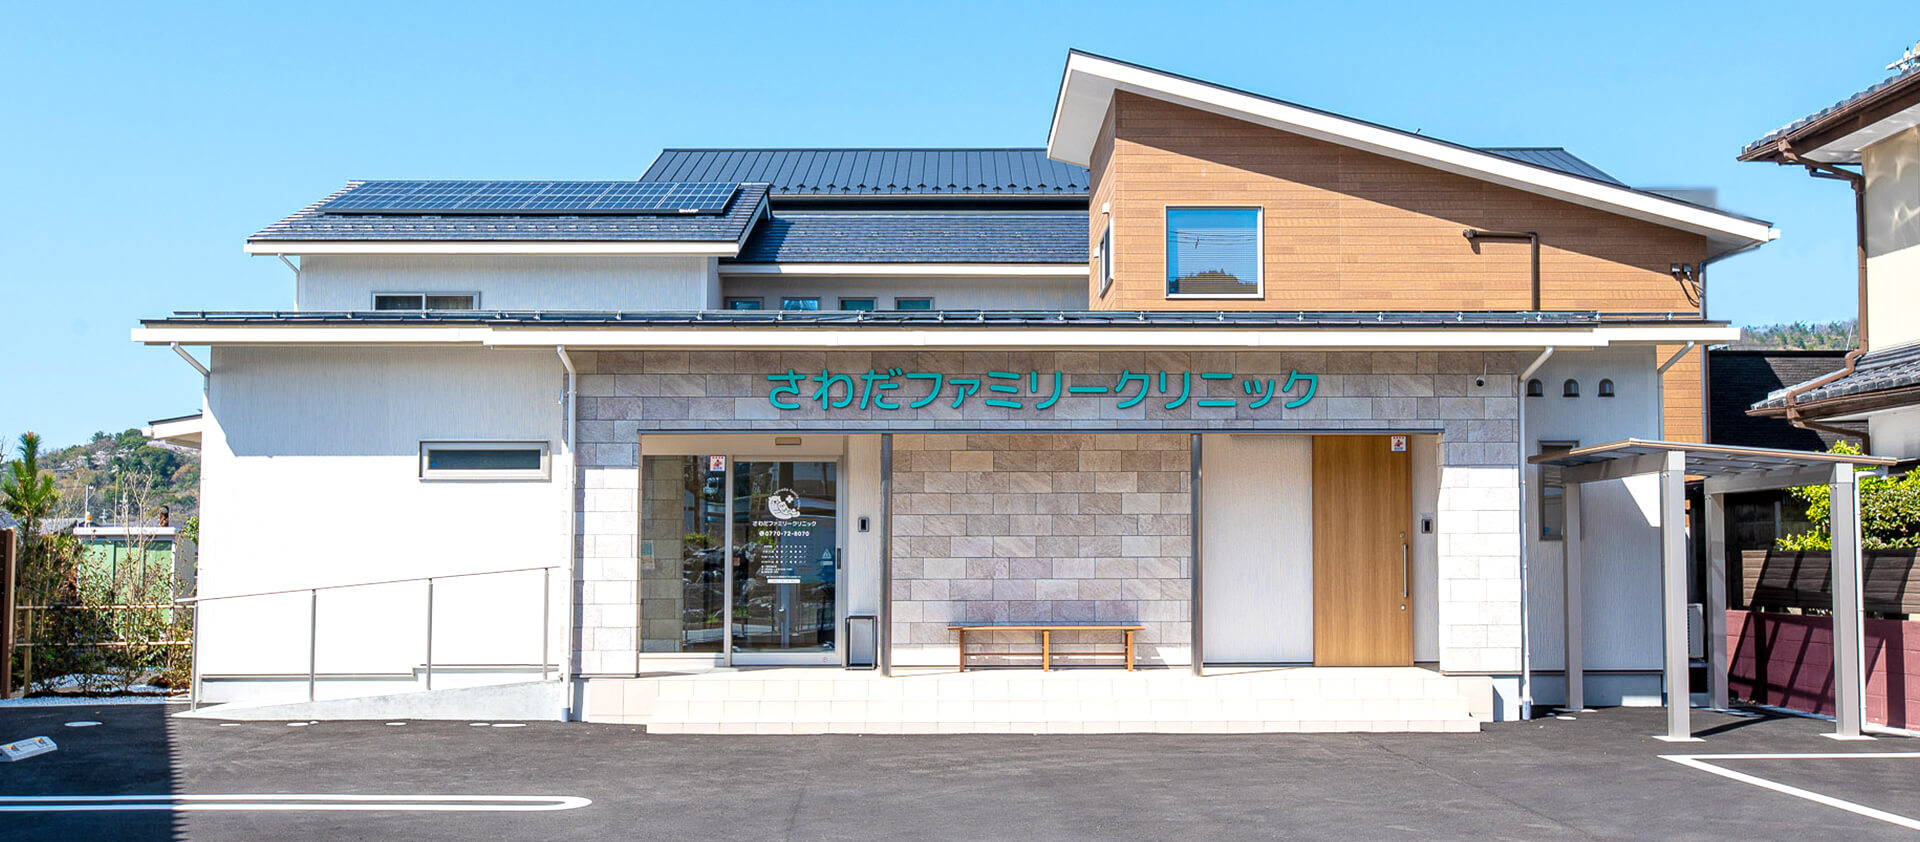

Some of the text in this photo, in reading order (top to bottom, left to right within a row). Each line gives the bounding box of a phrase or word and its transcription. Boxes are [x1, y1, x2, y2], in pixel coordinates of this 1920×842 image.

[767, 368, 1318, 410] さわだファミリークリニック
